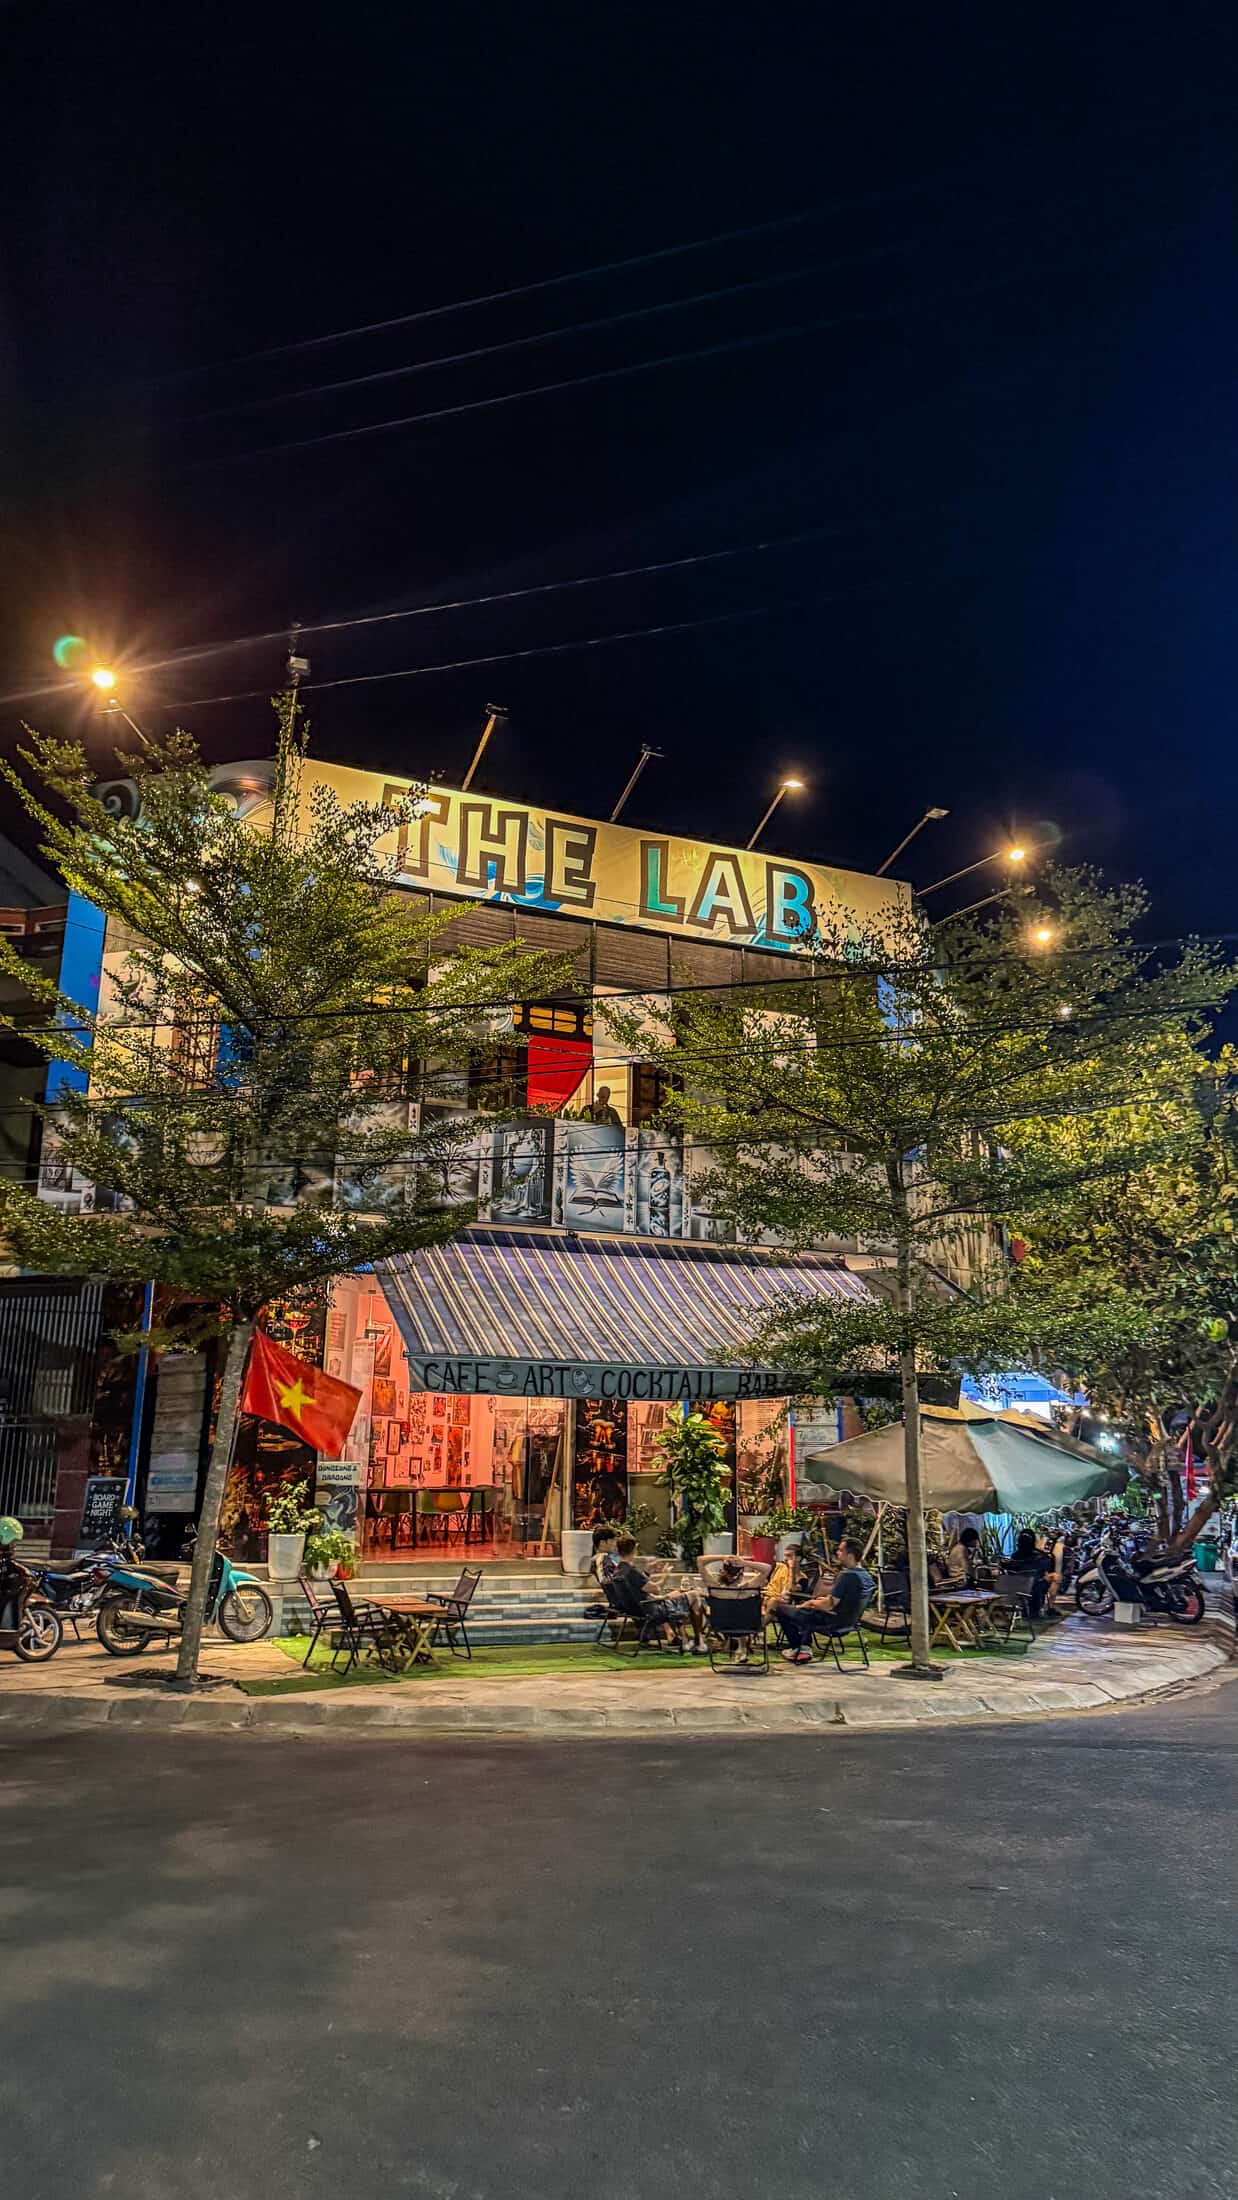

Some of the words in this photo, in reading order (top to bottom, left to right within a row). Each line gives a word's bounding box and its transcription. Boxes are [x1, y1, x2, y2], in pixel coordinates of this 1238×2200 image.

[383, 783, 597, 909] THE
[639, 840, 818, 944] LAB
[423, 1362, 491, 1394] CAFE
[523, 1365, 571, 1397] ART
[600, 1369, 720, 1399] COCKTAIL
[93, 1493, 116, 1501] BOARD
[91, 1501, 114, 1509] GAME
[89, 1509, 113, 1517] NIGHT
